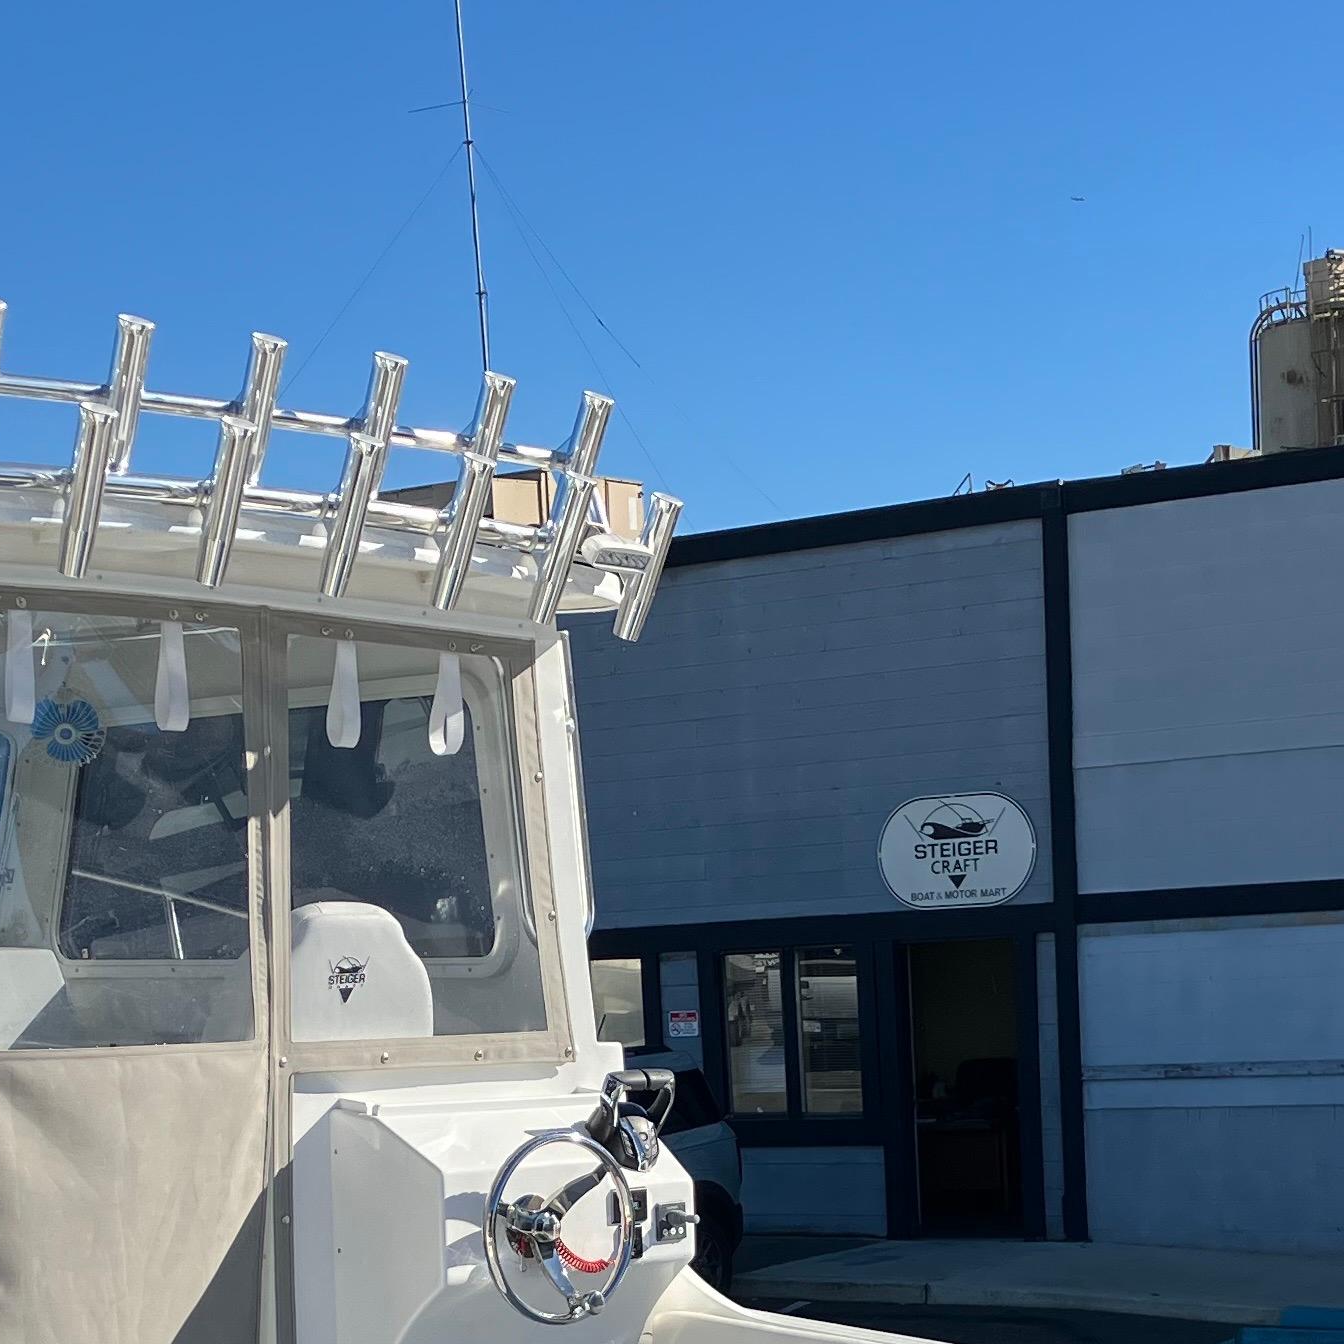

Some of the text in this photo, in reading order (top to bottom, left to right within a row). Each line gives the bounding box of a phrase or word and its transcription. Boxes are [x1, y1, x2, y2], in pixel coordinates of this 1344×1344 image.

[914, 839, 998, 860] STEIGER
[931, 857, 980, 875] CRAFT
[911, 891, 934, 902] BOAT
[945, 888, 978, 900] MOTOR
[980, 887, 1007, 898] MART
